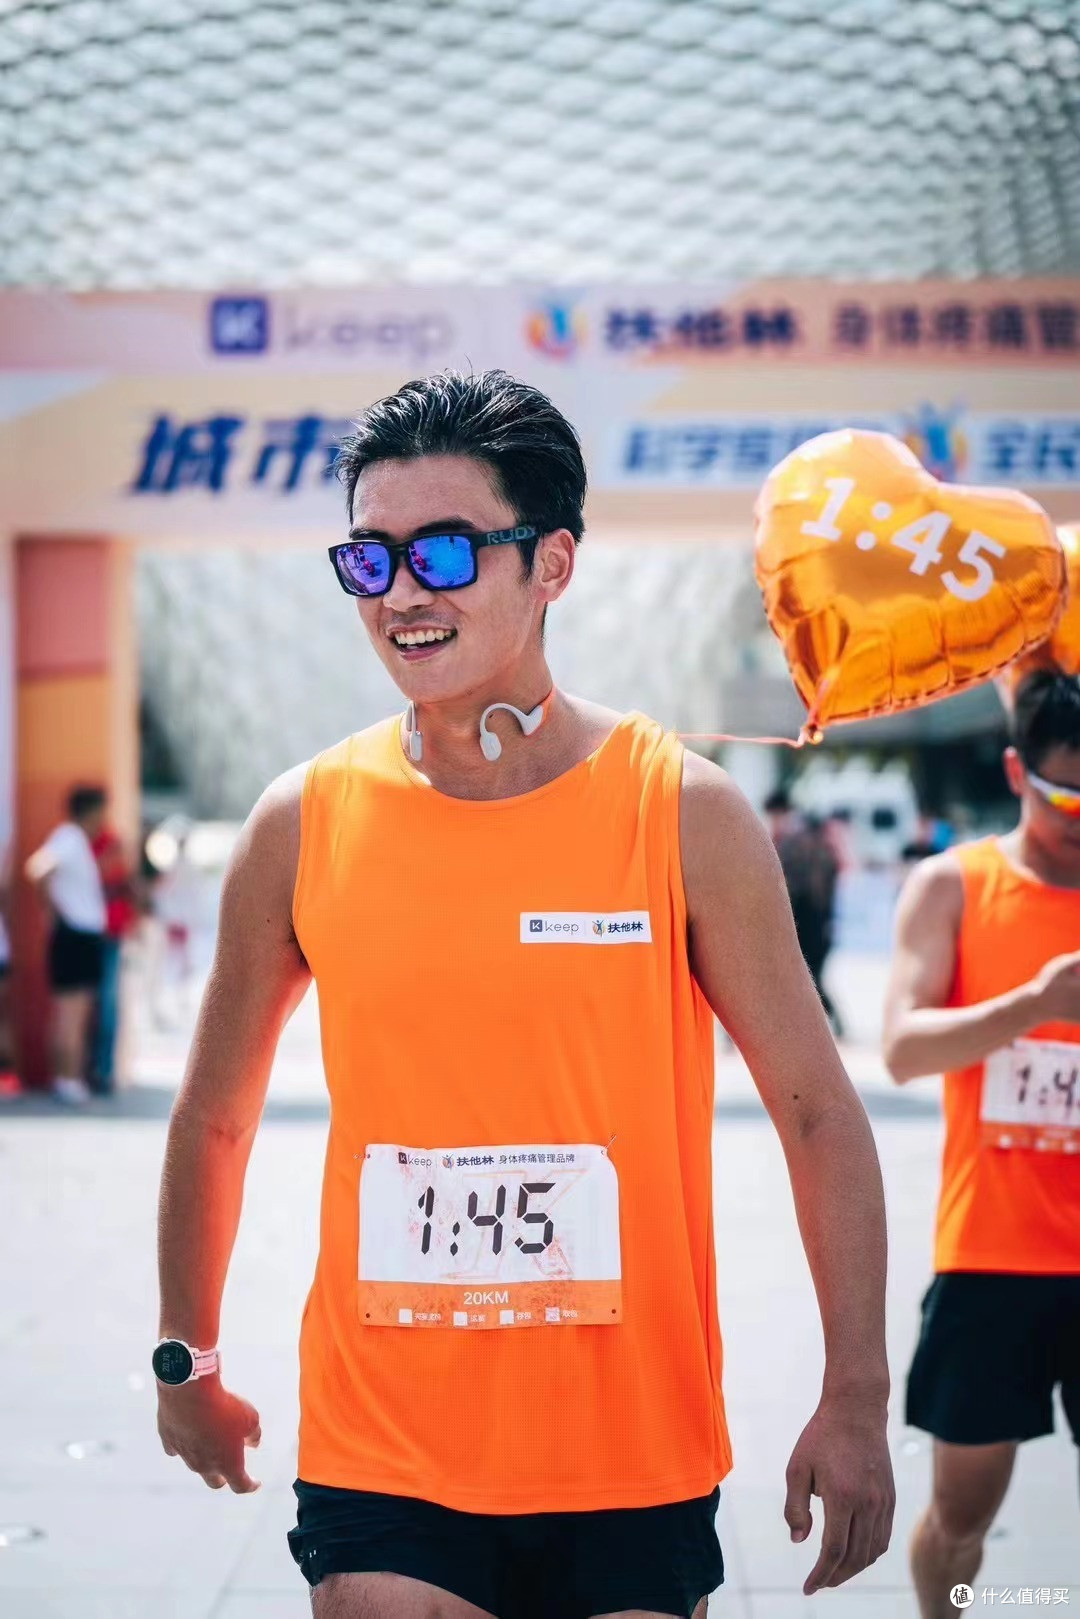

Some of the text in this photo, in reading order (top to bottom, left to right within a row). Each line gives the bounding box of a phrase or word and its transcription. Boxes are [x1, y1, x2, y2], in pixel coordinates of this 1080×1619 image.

[800, 477, 1006, 602] 1:45
[545, 921, 579, 935] keep
[607, 921, 644, 934] 扶他林
[408, 1154, 432, 1168] keep
[457, 1154, 575, 1167] 扶他林 身体疼痛管理品牌
[418, 1182, 556, 1257] 1:45
[463, 1291, 509, 1305] 20KM
